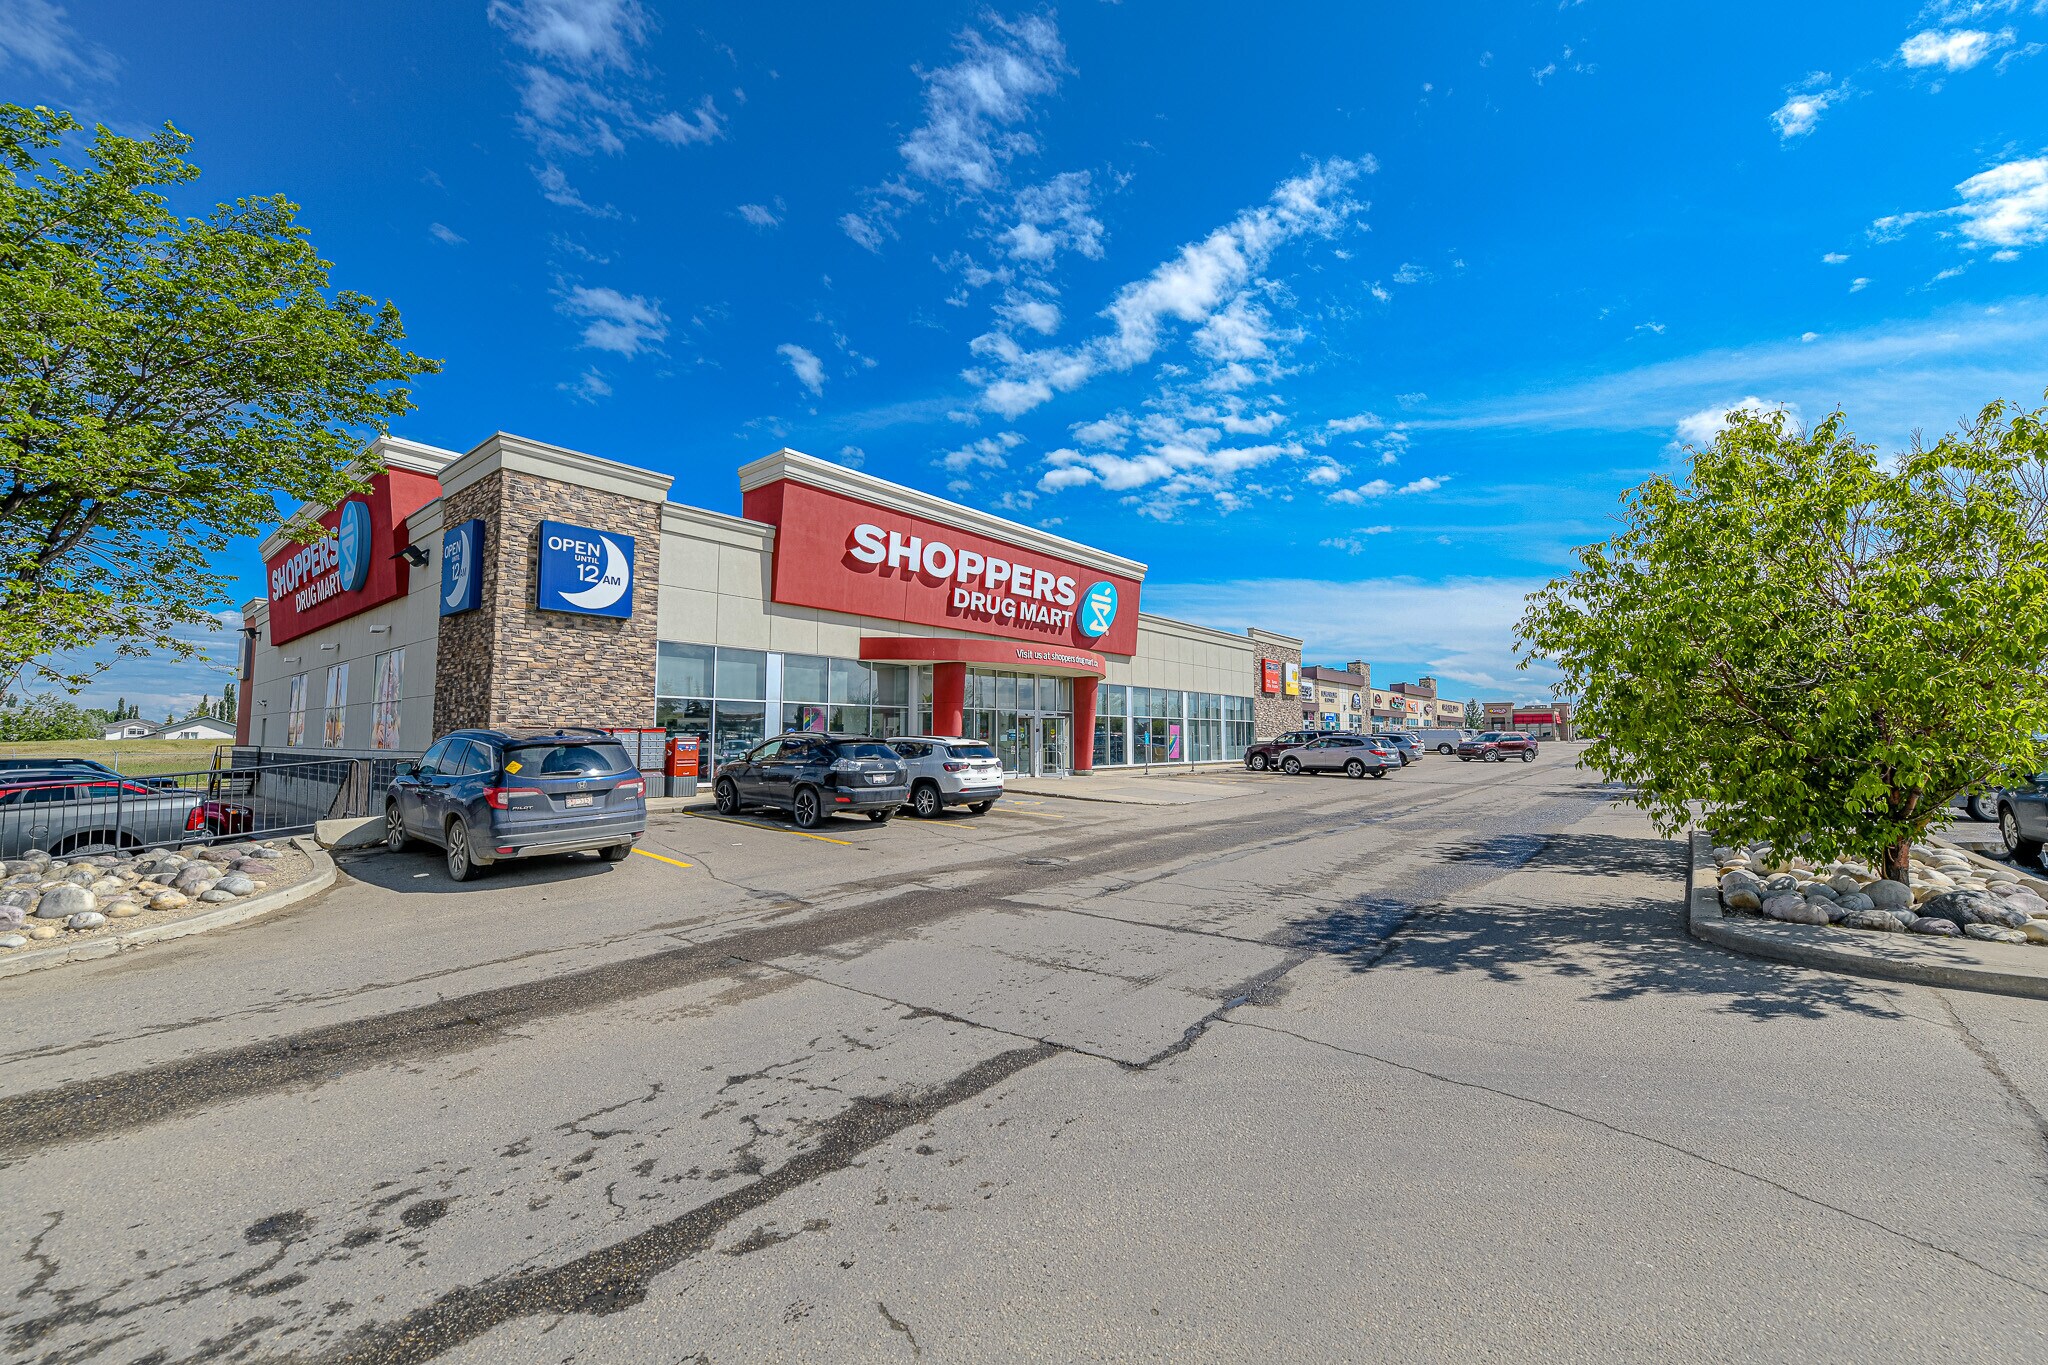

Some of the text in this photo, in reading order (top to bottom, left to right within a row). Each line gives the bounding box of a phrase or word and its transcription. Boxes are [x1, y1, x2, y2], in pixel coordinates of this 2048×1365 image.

[444, 540, 461, 559] OPEN
[548, 536, 601, 557] OPEN
[272, 527, 339, 602] SHOPPERS
[574, 554, 600, 565] UNTIL
[849, 523, 1077, 606] SHOPPERS
[451, 562, 460, 581] 12
[576, 563, 621, 587] 12 AM
[295, 570, 341, 613] DRUG MART
[953, 587, 1073, 628] DRUG MART
[1016, 648, 1033, 660] Visit
[1034, 651, 1043, 660] us
[1043, 652, 1051, 660] at
